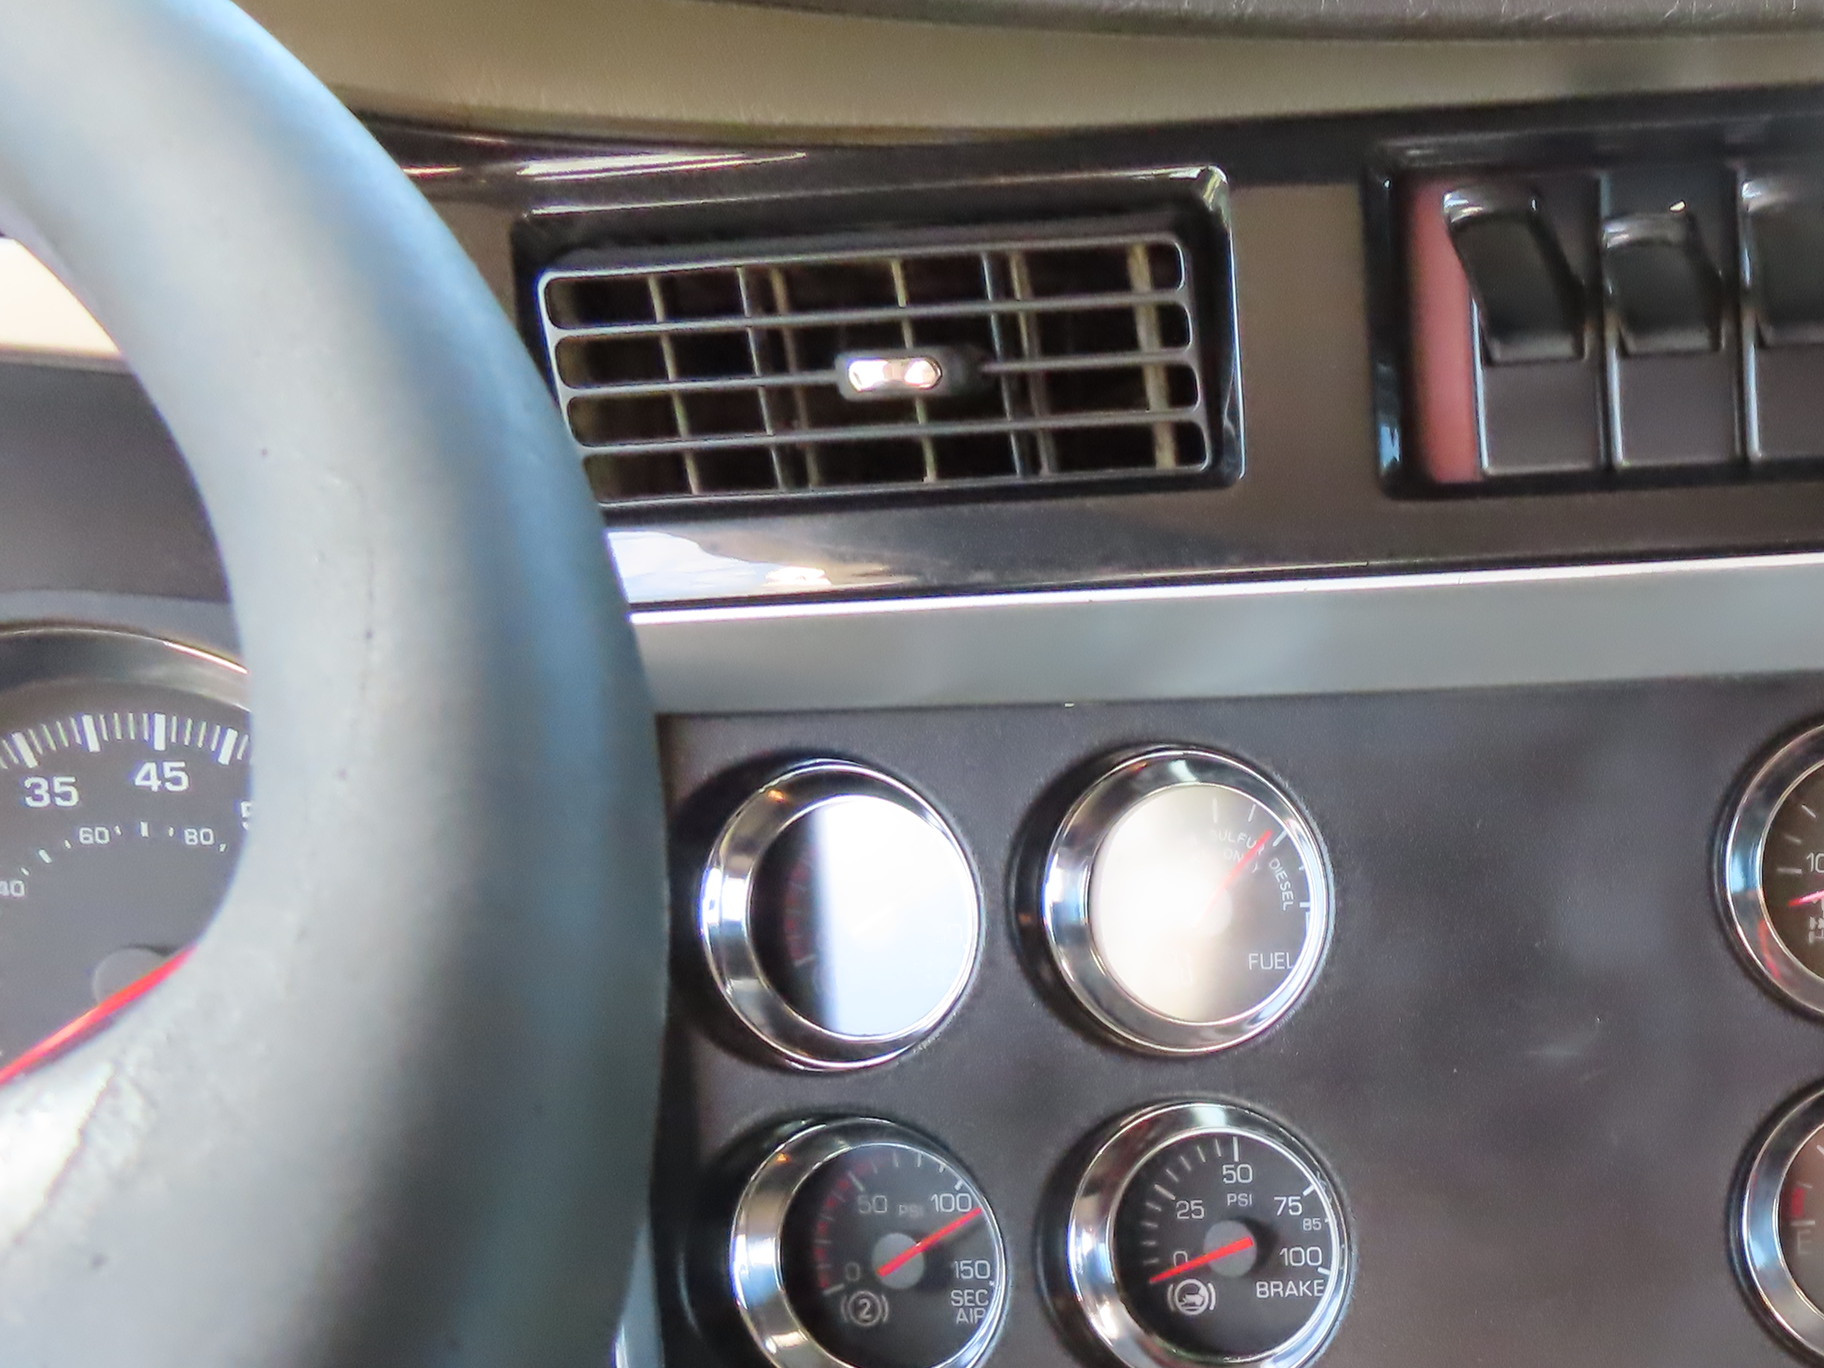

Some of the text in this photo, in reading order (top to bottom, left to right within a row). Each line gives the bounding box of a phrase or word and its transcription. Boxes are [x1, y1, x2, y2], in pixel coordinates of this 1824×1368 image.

[134, 761, 189, 792] 45
[24, 776, 79, 807] 35
[79, 827, 110, 844] 60
[184, 828, 215, 845] 80
[1268, 857, 1294, 911] DIESEL
[1249, 952, 1294, 970] FUEL
[1222, 1164, 1253, 1184] 50
[858, 1193, 972, 1217] 50 PSI 100
[1176, 1200, 1205, 1219] 25
[1227, 1193, 1252, 1207] PSI
[1274, 1196, 1303, 1216] 75
[1303, 1218, 1322, 1231] 85
[1279, 1247, 1323, 1267] 100
[954, 1259, 991, 1280] 150
[951, 1289, 989, 1307] SEC
[1256, 1280, 1325, 1299] BRAKE
